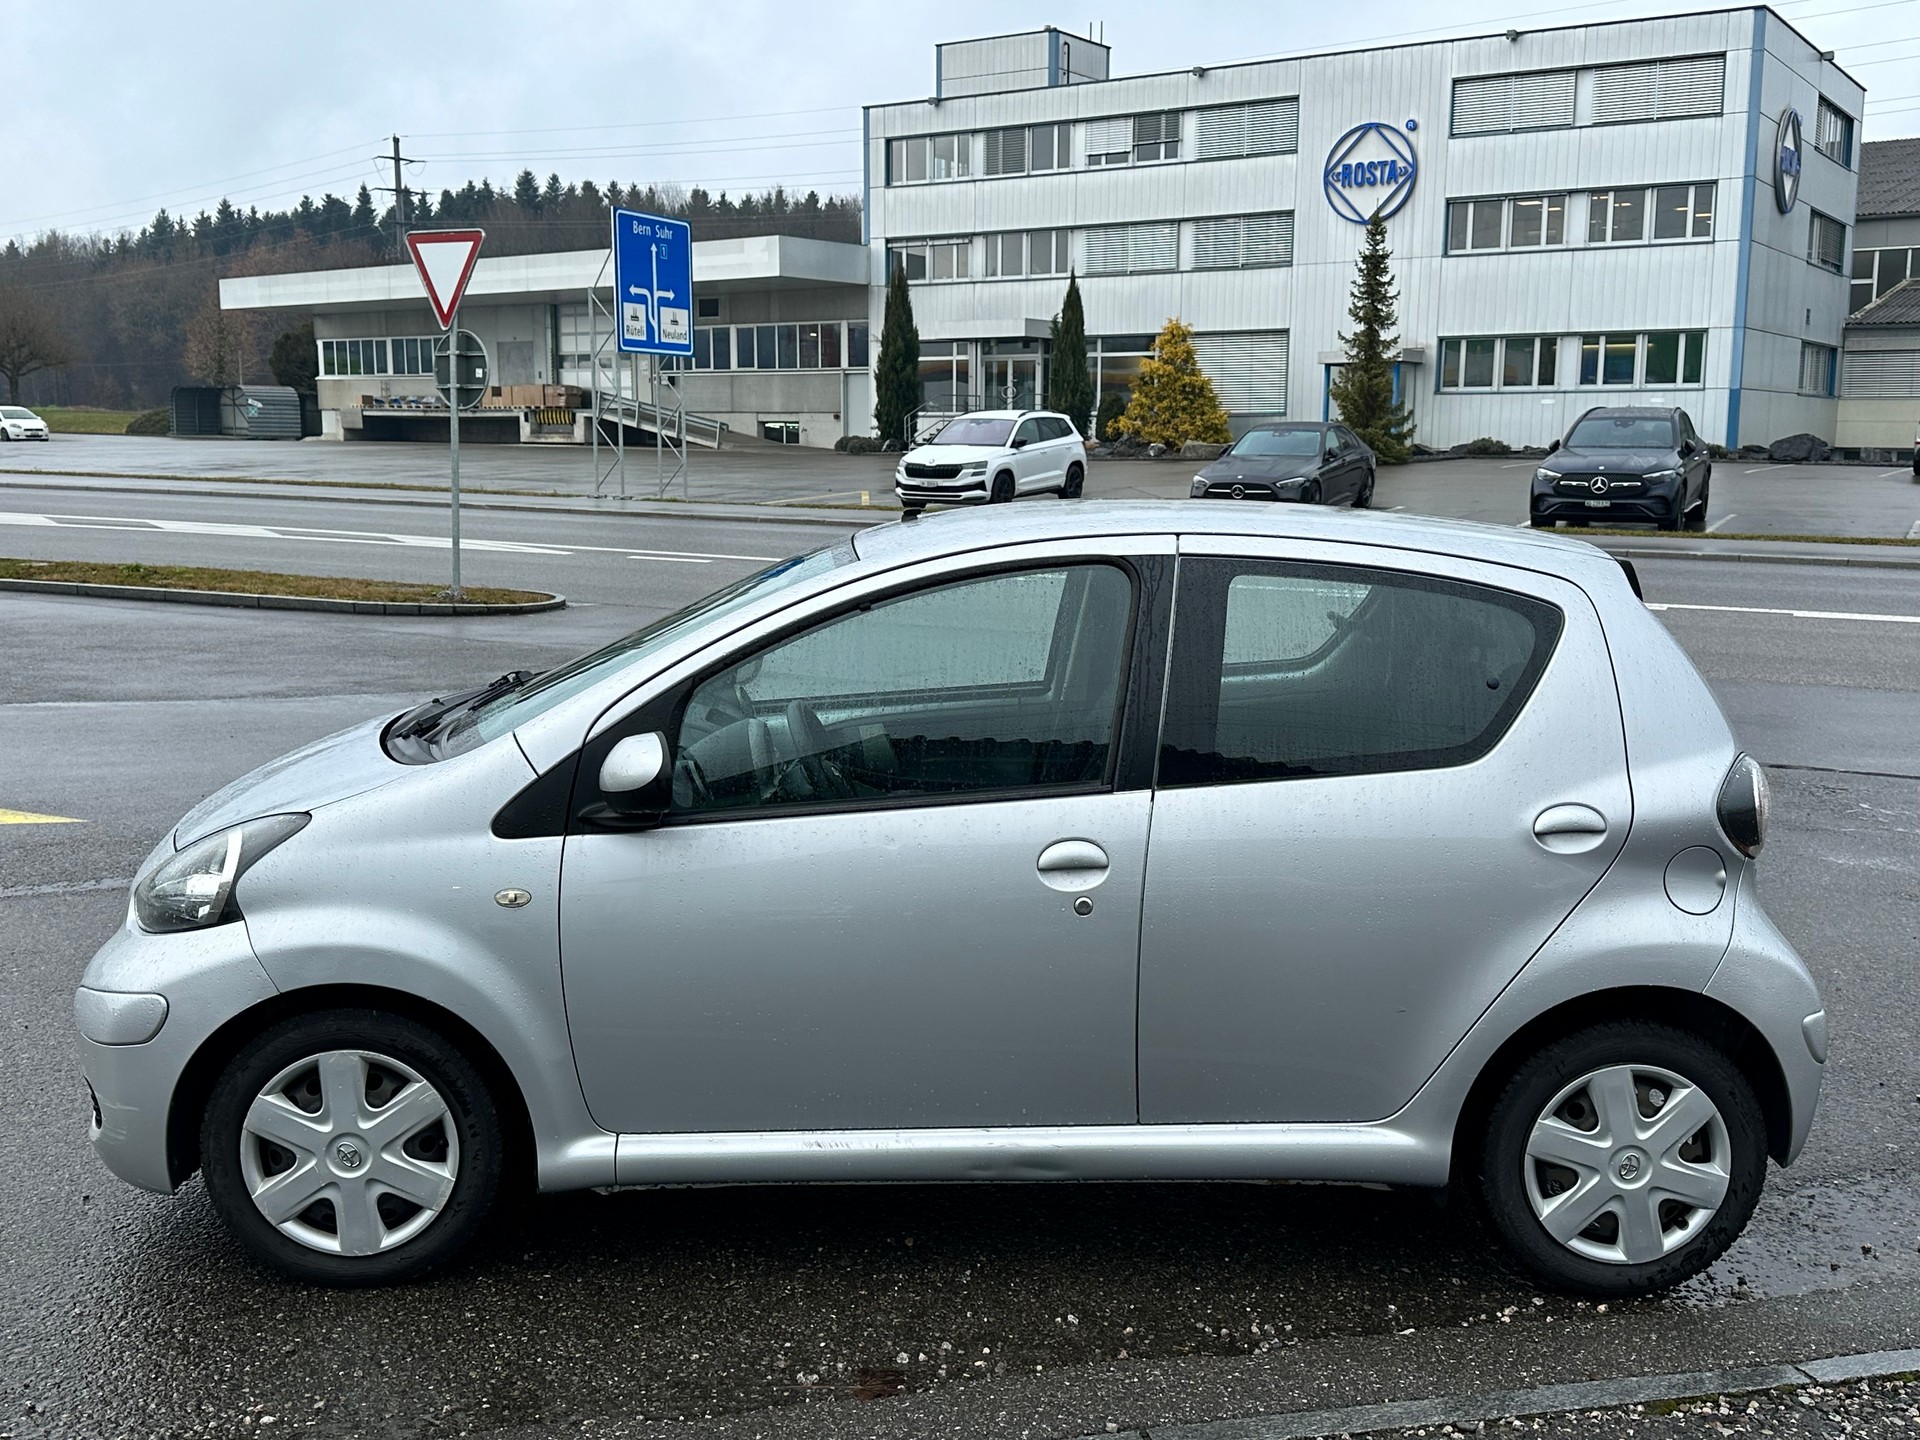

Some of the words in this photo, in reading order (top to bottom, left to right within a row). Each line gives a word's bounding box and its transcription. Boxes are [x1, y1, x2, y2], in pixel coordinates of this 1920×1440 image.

[633, 221, 651, 236] Bern
[655, 225, 673, 240] Suhr
[626, 325, 645, 338] Rüteli
[662, 329, 688, 341] Neuland
